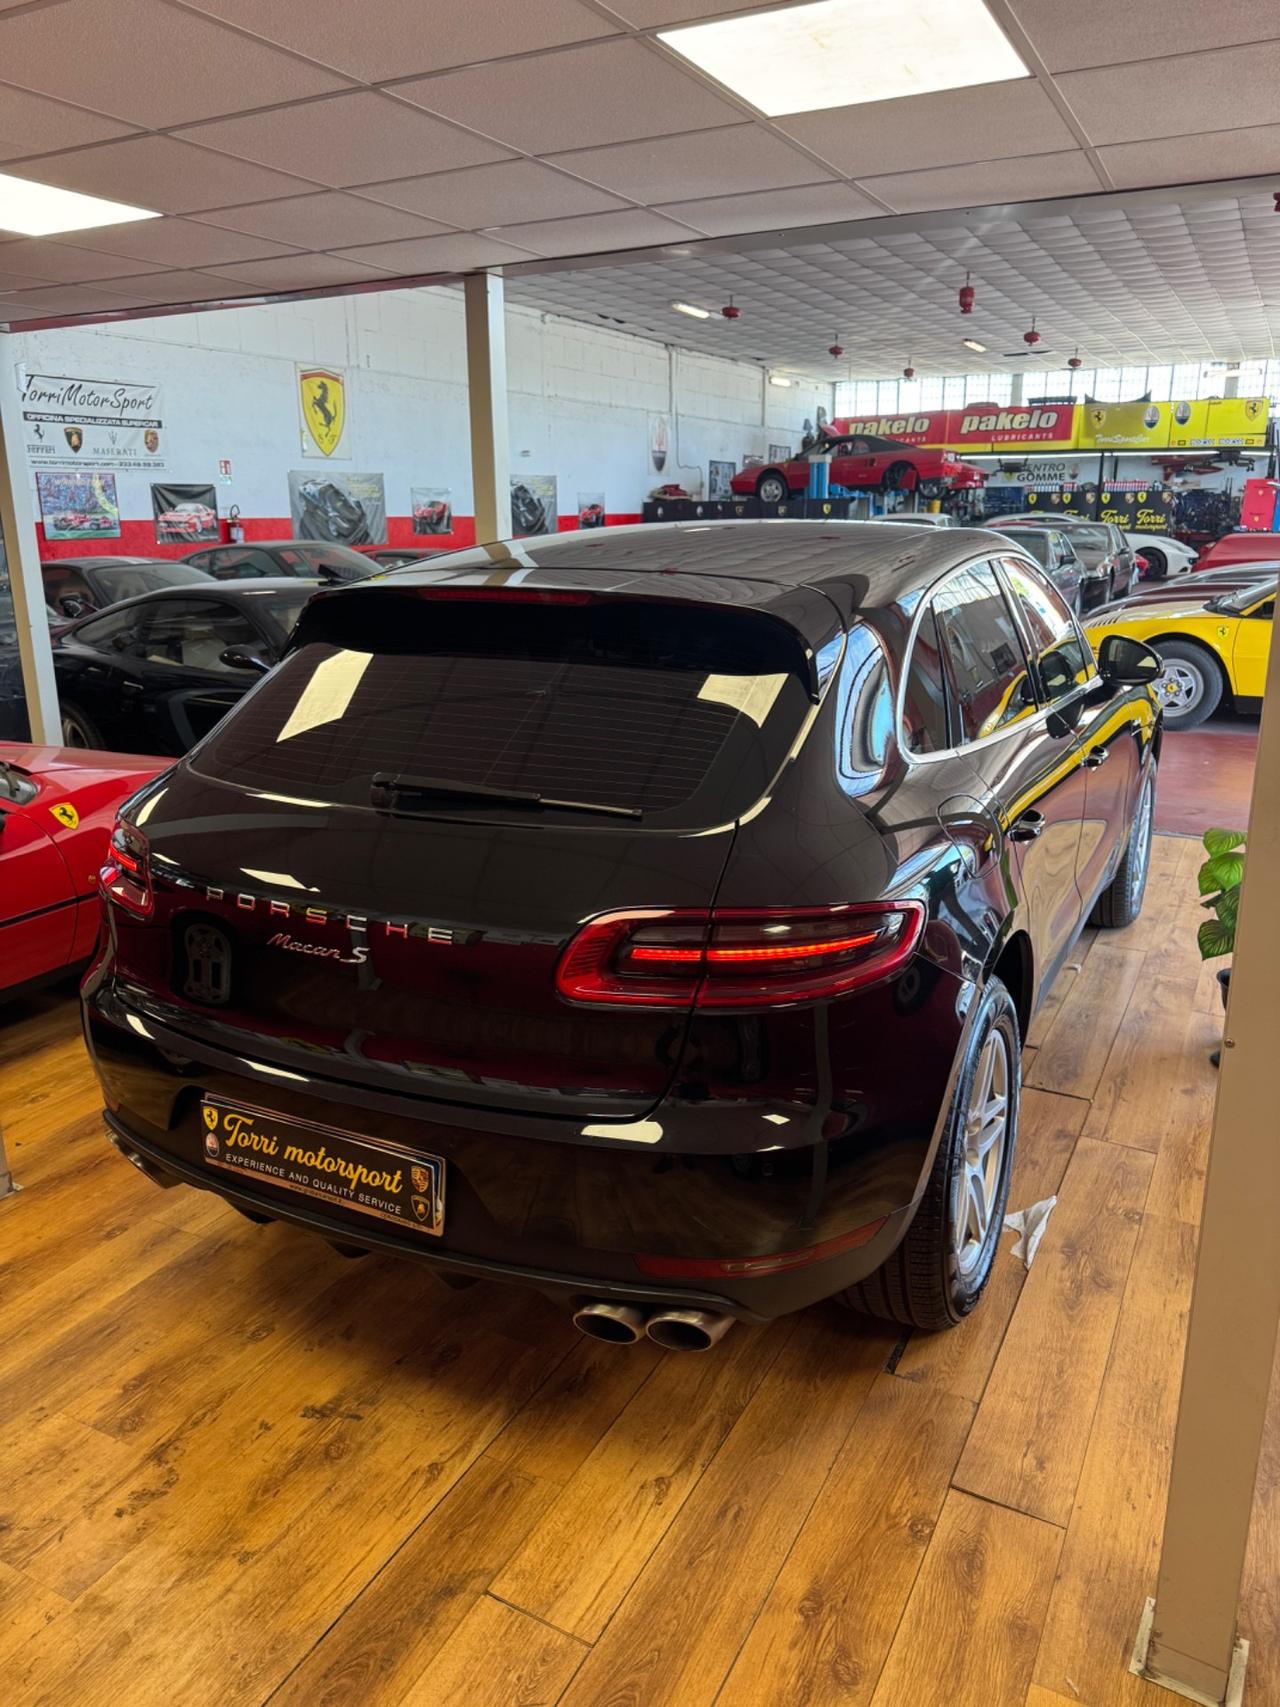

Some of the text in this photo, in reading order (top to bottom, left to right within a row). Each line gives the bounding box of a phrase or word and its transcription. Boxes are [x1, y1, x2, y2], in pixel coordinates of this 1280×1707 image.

[960, 409, 1058, 434] pakelo
[991, 433, 1053, 441] LUBRICANTS
[92, 447, 137, 456] MASERATI
[1017, 472, 1066, 482] GOMME
[1026, 463, 1065, 472] ENTRO
[1136, 508, 1167, 524] Torri
[206, 886, 453, 945] PORSCHE
[267, 933, 370, 964] Macan S
[223, 1113, 279, 1156] Torri
[283, 1144, 403, 1194] motorsport
[225, 1153, 286, 1177] EXPERIENCE
[288, 1172, 309, 1184] AND
[312, 1178, 355, 1199] QUALITY
[358, 1193, 402, 1215] SERVICE
